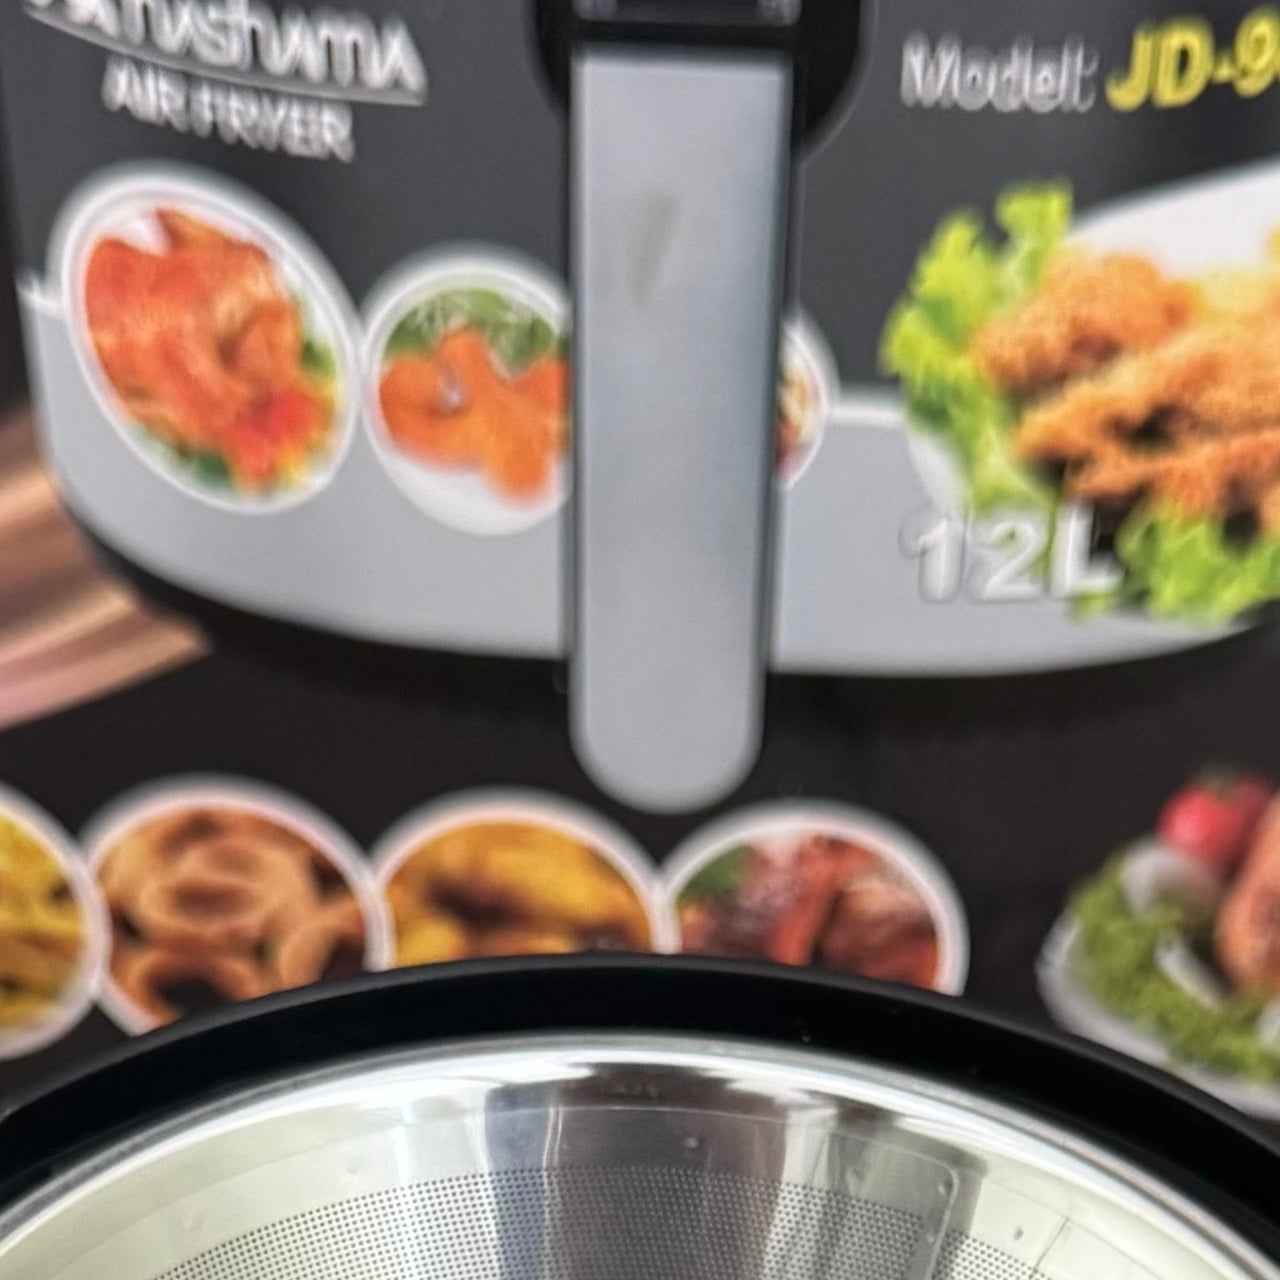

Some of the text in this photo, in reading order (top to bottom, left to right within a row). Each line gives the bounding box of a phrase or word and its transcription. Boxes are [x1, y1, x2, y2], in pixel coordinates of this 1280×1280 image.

[102, 55, 356, 163] AIR FRYER
[901, 30, 1098, 113] Model:
[900, 502, 1128, 602] 12L
